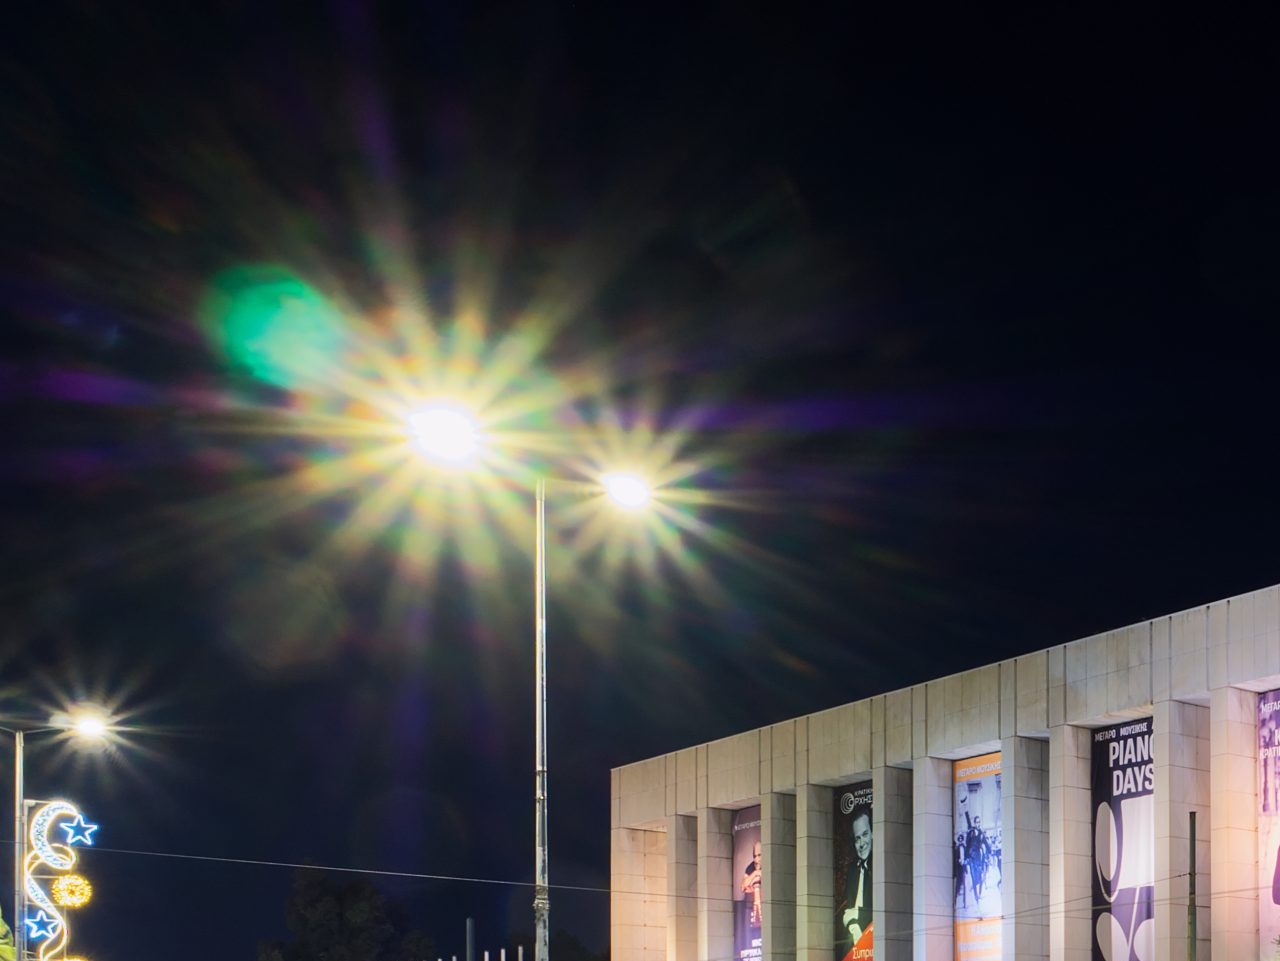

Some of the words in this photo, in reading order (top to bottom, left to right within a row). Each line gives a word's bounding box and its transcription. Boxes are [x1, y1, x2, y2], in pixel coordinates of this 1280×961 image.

[1094, 729, 1116, 742] ΜΕΓΑΡΟ
[1120, 722, 1148, 737] ΜΟΥΣΙΚΗΣ
[1113, 763, 1154, 796] DAYS
